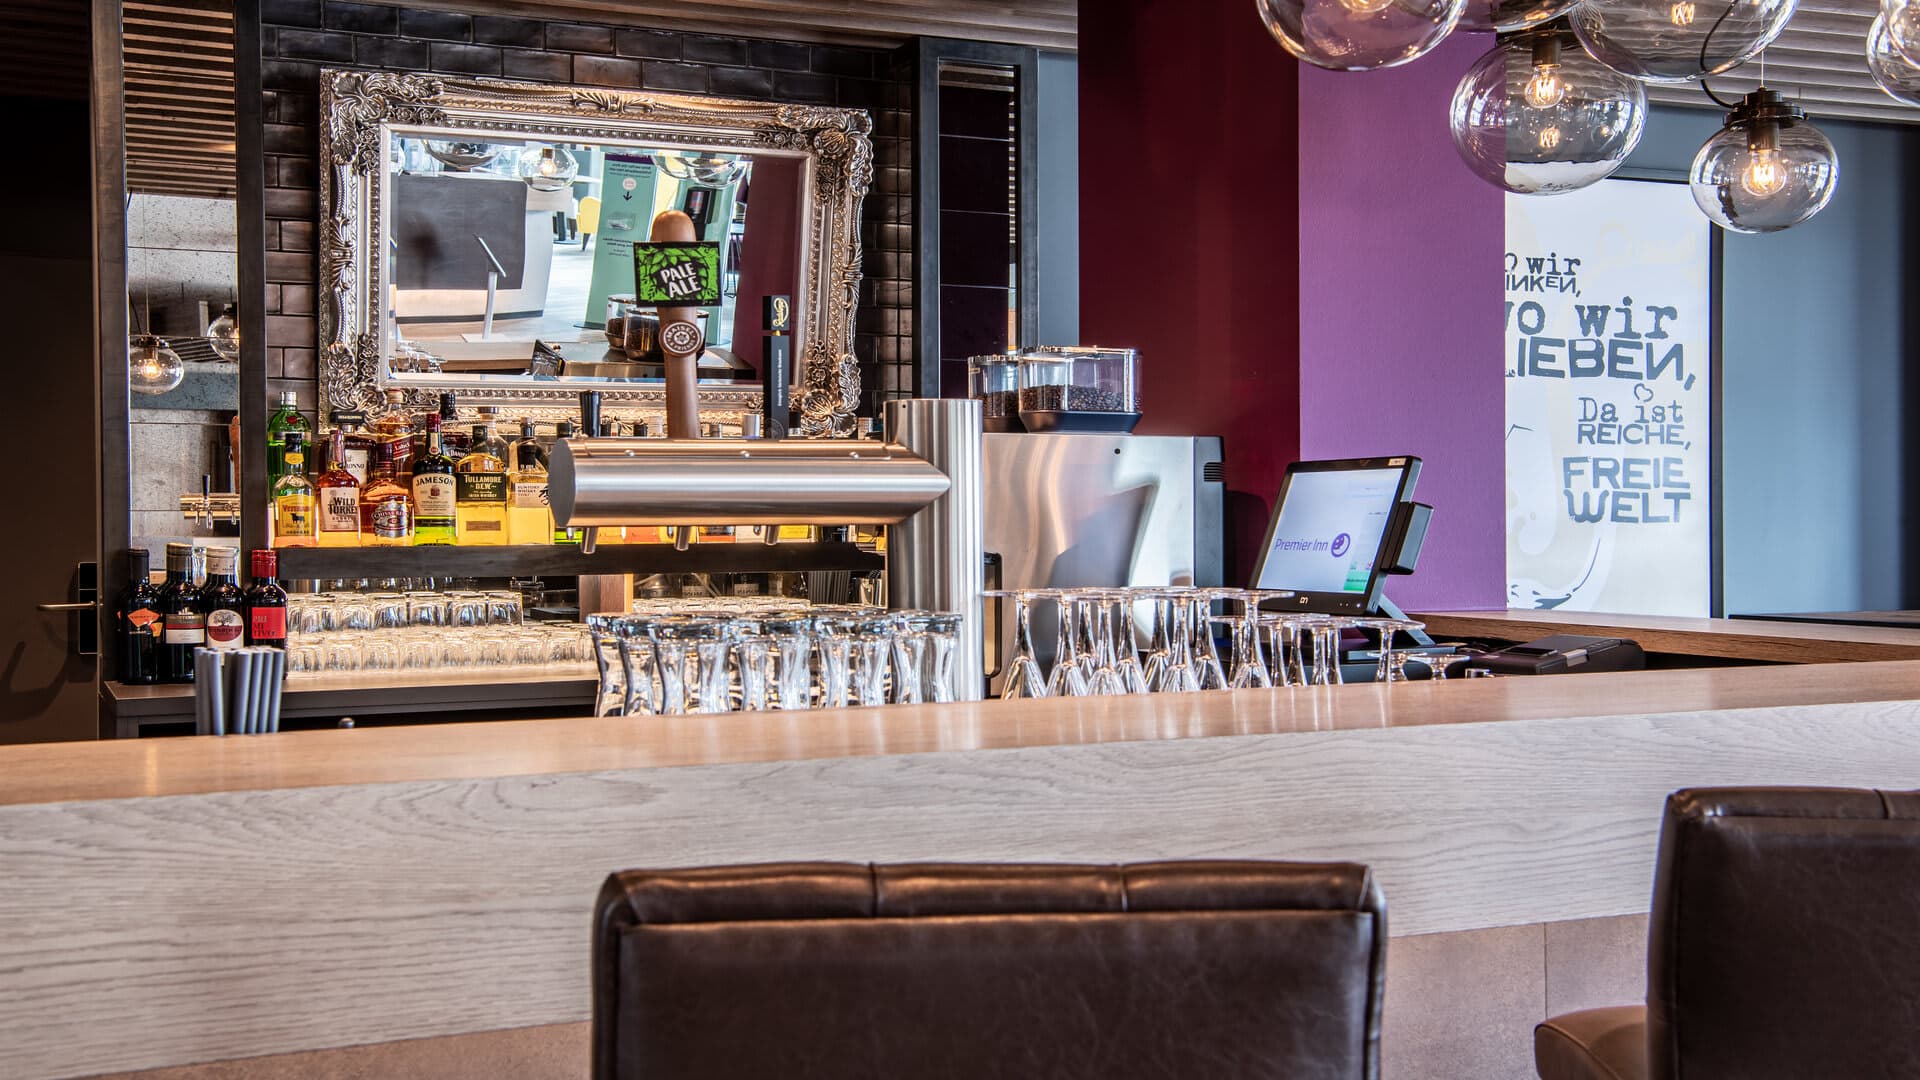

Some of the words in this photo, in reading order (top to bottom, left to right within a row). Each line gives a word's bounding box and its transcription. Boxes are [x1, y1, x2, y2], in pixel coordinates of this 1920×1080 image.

[660, 262, 697, 284] PALE
[1525, 252, 1581, 275] wir
[668, 276, 702, 298] ALE
[1574, 296, 1678, 339] wir
[1505, 336, 1696, 391] IEBEN,
[1578, 397, 1619, 423] Da
[1634, 389, 1683, 424] ist
[1577, 423, 1691, 450] REICHE,
[415, 476, 454, 487] JAMESON
[463, 474, 503, 483] TULLAMORE
[1562, 456, 1691, 489] FREIE
[333, 496, 356, 506] WILD
[1563, 489, 1691, 523] WELT
[1274, 538, 1312, 551] Premier
[1312, 539, 1329, 551] Inn
